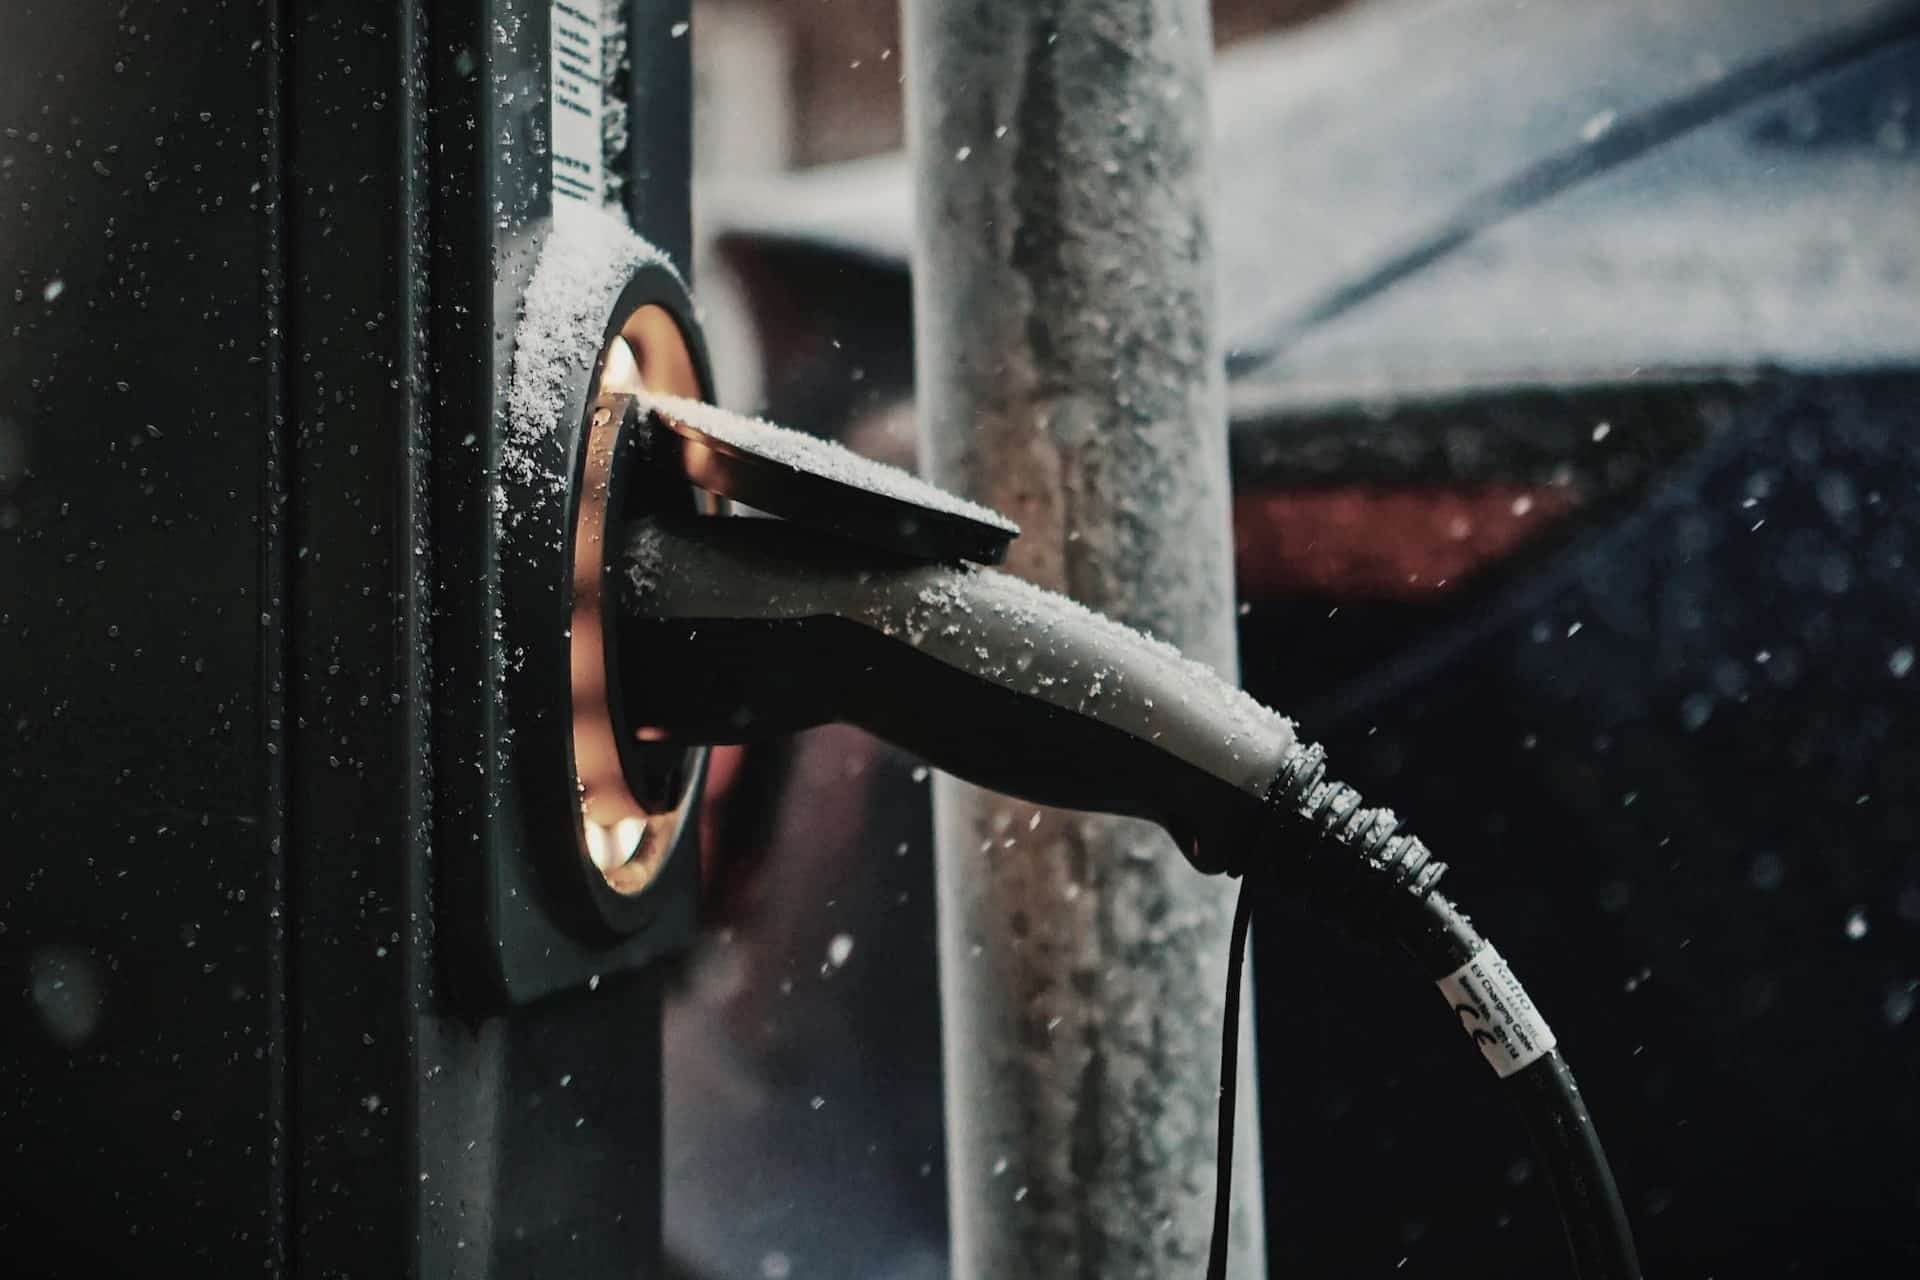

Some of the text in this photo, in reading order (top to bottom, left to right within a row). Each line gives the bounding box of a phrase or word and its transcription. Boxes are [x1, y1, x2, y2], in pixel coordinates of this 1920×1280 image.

[1471, 963, 1485, 978] EV
[1482, 979, 1514, 1025] Charging
[1513, 1023, 1533, 1052] Cable
